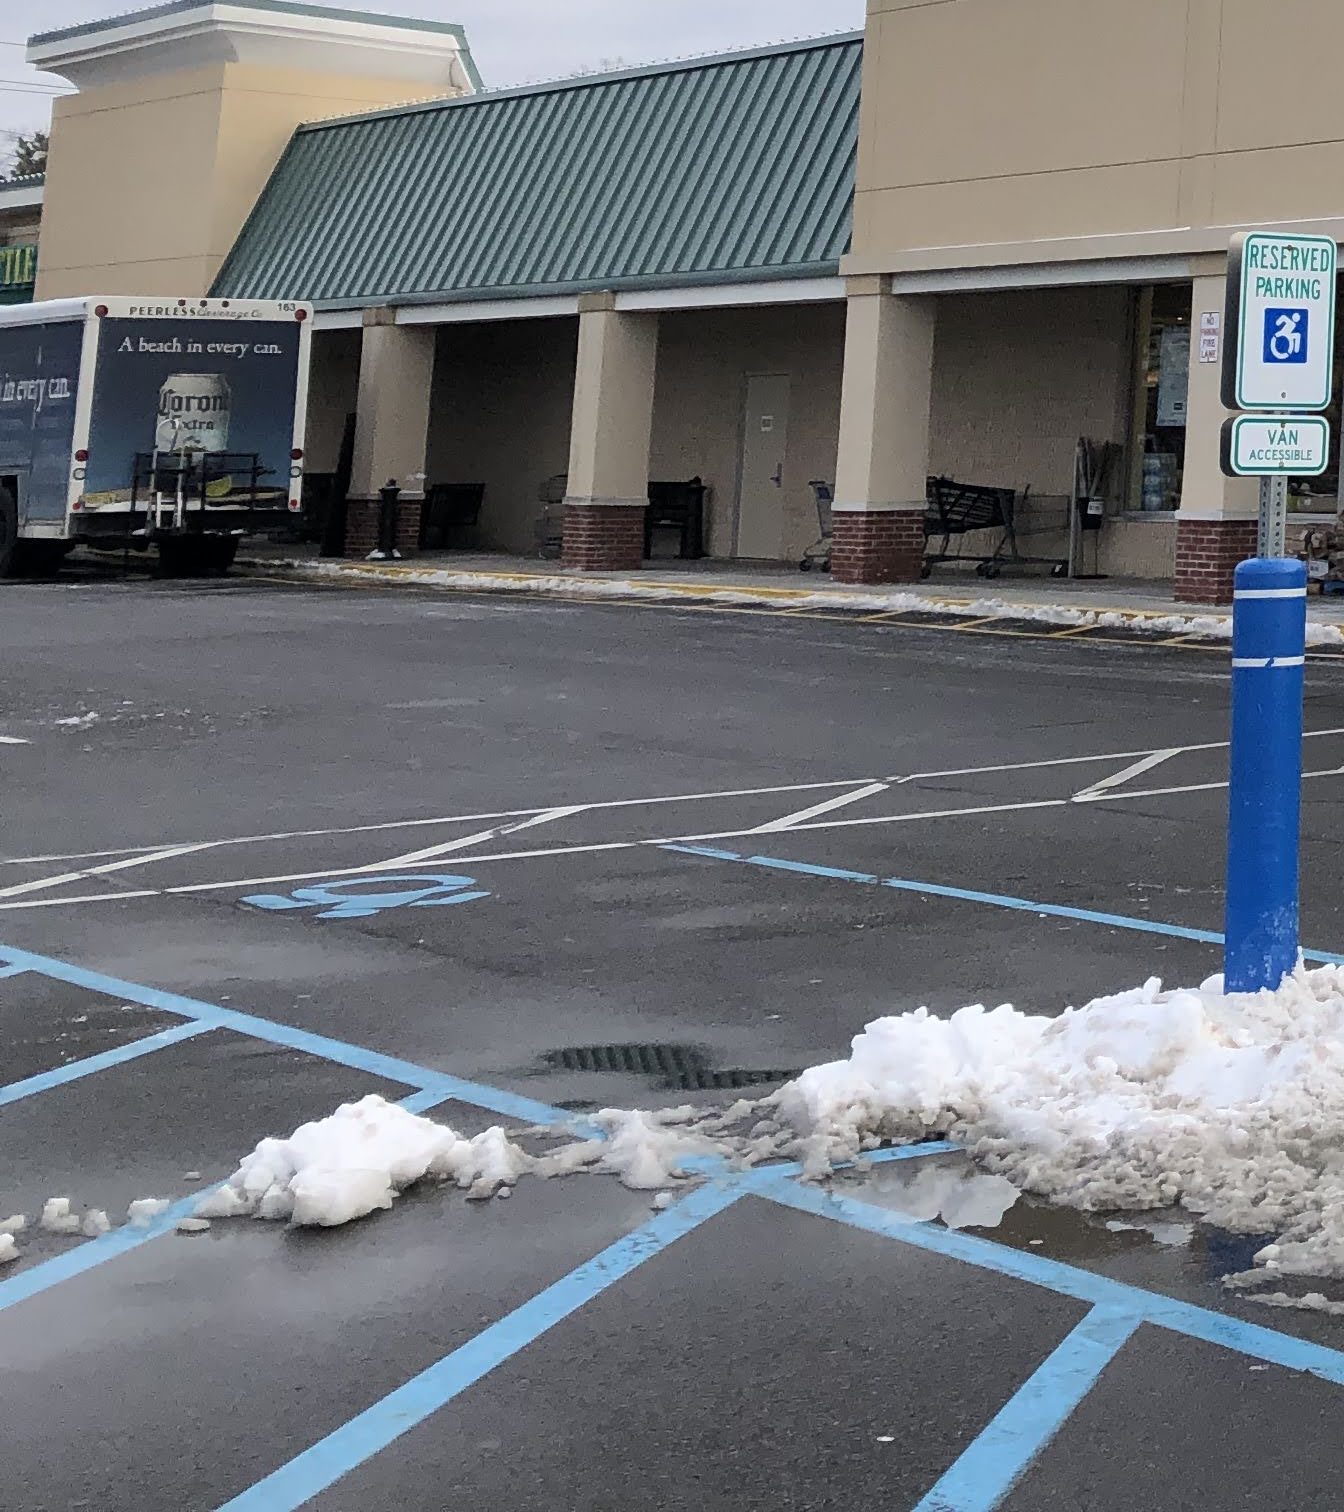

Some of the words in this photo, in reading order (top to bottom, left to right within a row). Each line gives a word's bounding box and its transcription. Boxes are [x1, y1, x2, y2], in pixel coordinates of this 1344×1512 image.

[1249, 244, 1330, 272] RESERVED
[1256, 276, 1321, 300] PARKING
[129, 306, 196, 317] PEERLESS
[118, 336, 133, 352] A
[139, 337, 182, 353] beach
[187, 338, 202, 354] in
[206, 343, 249, 359] every
[253, 343, 282, 355] can.
[16, 378, 46, 412] every
[157, 389, 228, 418] Coron
[1267, 429, 1299, 446] VAN
[1248, 449, 1313, 461] ACCESSIBLE
